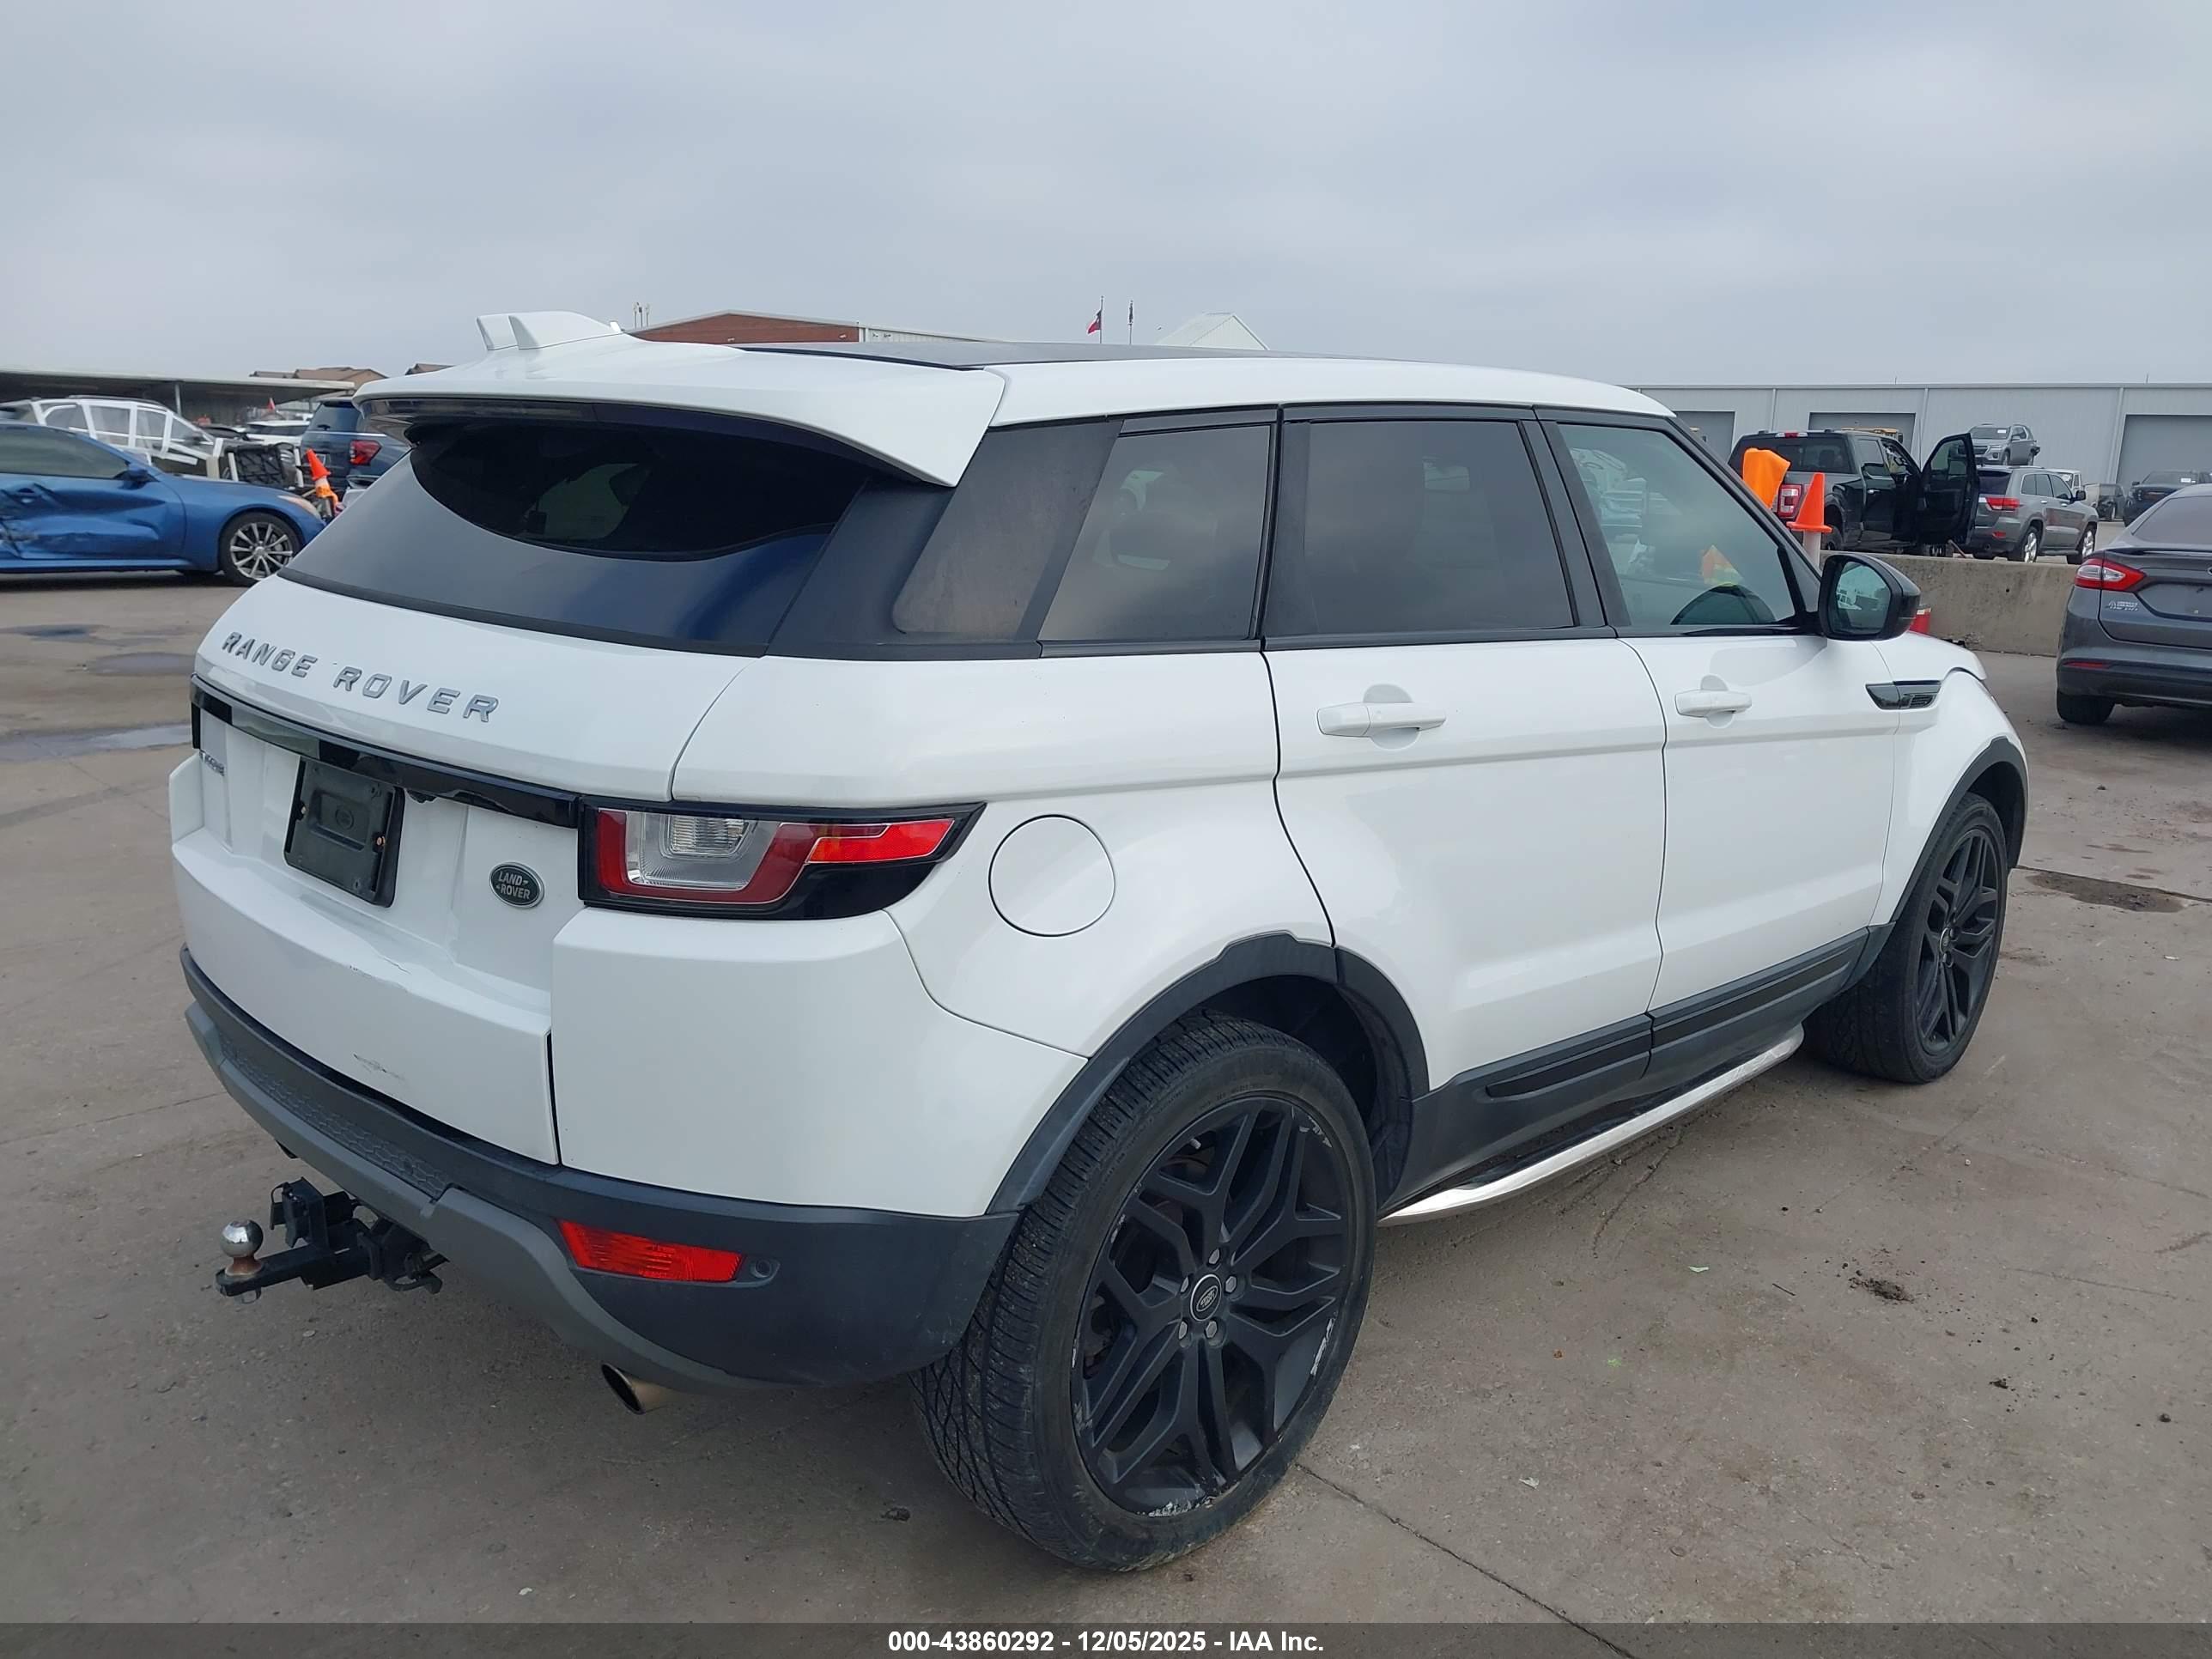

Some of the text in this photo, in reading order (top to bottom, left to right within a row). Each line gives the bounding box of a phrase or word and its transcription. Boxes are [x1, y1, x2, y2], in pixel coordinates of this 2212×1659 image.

[221, 631, 500, 723] RANGE ROVER
[499, 871, 523, 885] LAND
[501, 884, 531, 899] ROVER
